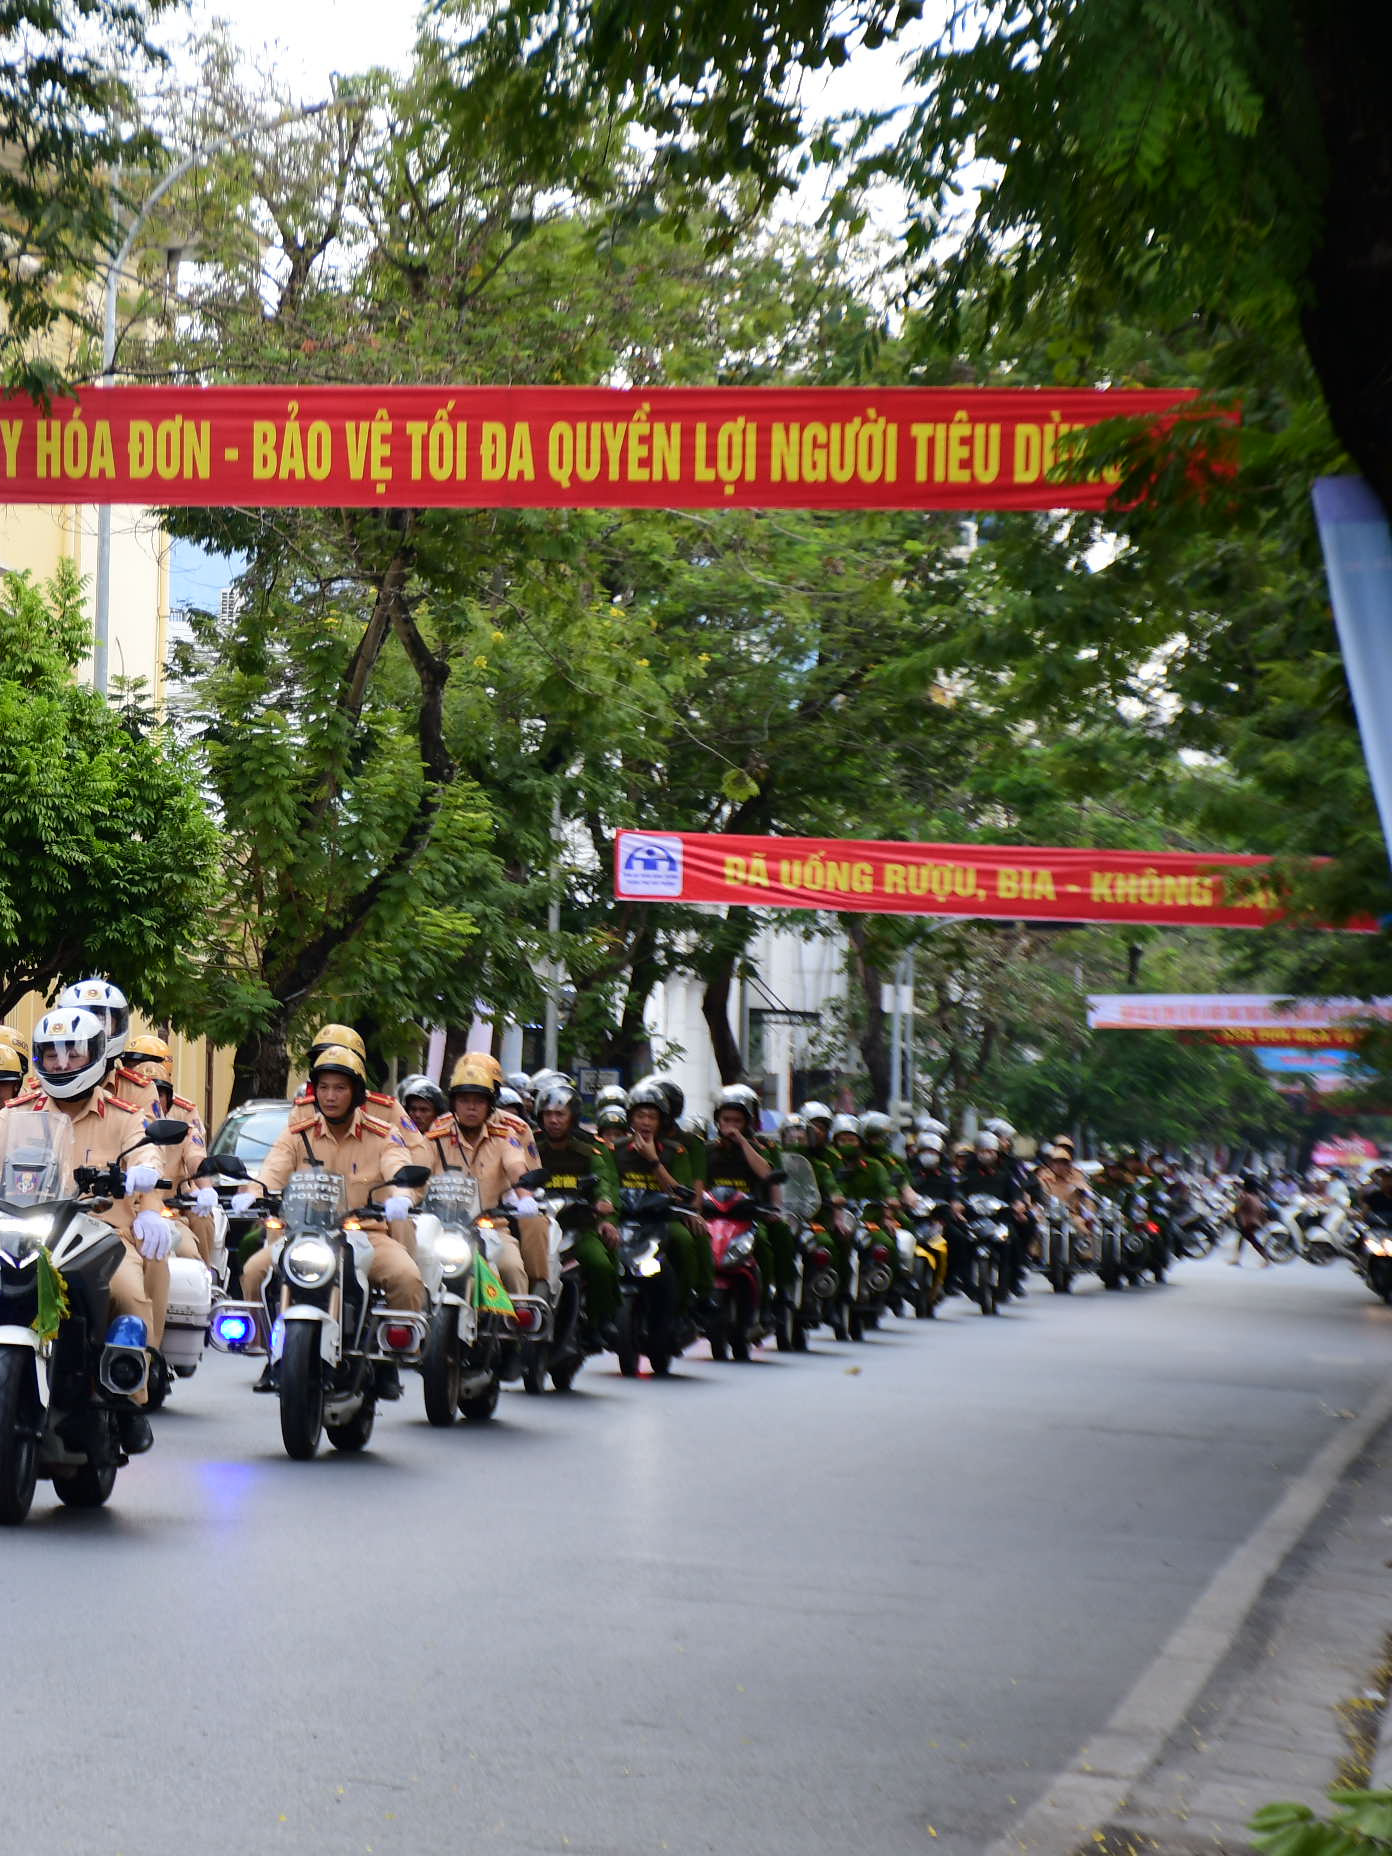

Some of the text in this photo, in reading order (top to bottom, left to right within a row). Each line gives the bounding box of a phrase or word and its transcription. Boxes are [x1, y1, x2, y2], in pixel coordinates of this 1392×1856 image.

[36, 406, 116, 479] HÓA
[128, 414, 210, 479] ĐƠN
[253, 401, 332, 480] BẢO
[345, 408, 393, 494] VỆ
[407, 400, 467, 481] TỐI
[480, 421, 535, 481] ĐA
[548, 402, 681, 488] QUYỀN
[694, 415, 757, 495] LỢI
[770, 408, 897, 483] NGƯỜI
[911, 411, 1001, 483] TIÊU
[1013, 410, 1124, 484] DÙ
[778, 850, 874, 893] UỐNG
[883, 862, 987, 902] RƯỢU,
[997, 869, 1056, 901] BIA
[1090, 867, 1214, 907] KHÔNG
[292, 1173, 344, 1184] CSGT
[291, 1183, 340, 1194] TRAFFIC
[289, 1191, 338, 1204] POLICE
